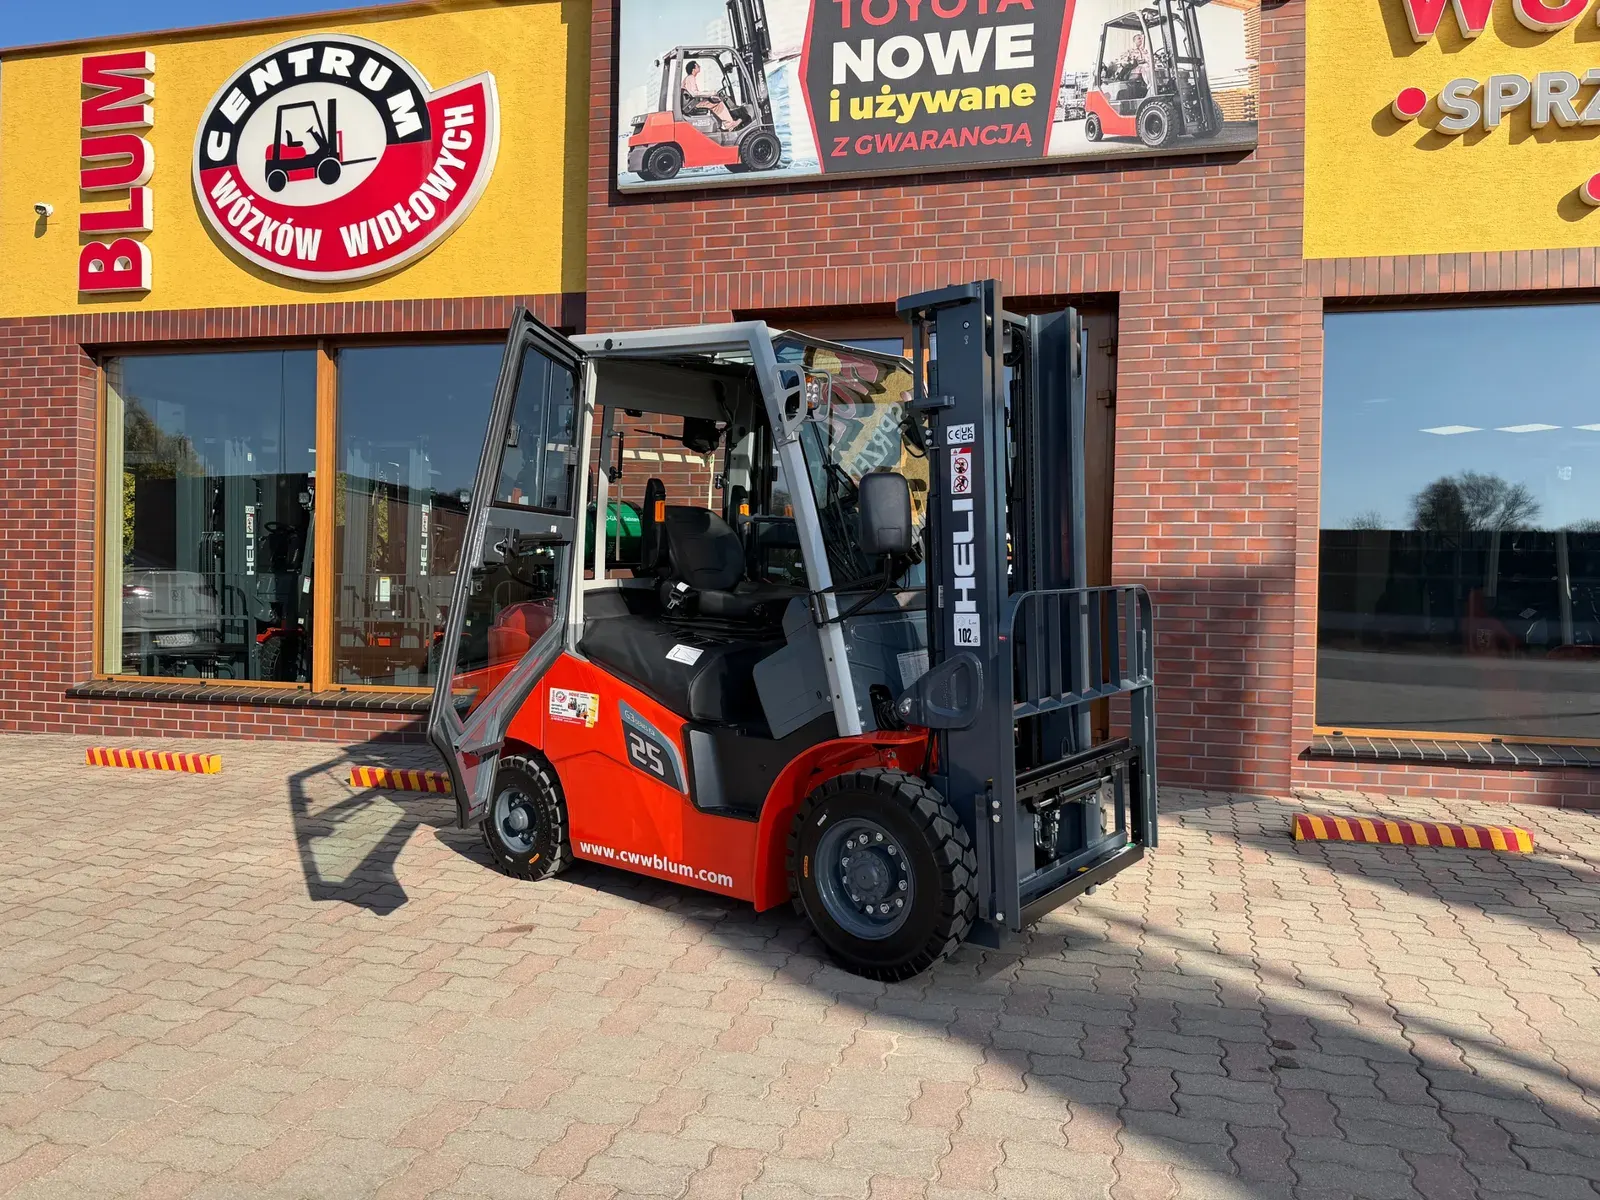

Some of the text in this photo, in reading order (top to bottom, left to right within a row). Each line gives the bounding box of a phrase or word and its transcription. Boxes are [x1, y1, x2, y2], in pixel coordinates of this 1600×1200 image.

[832, 0, 1035, 28] TOYO
[832, 23, 1035, 85] NOWE
[207, 46, 423, 162] CENTRUM
[829, 82, 1037, 124] i używane
[830, 122, 1033, 157] Z GWARANCJĄ
[79, 51, 155, 293] BLUM
[210, 103, 475, 261] WÓZKÓW WIDŁOWYCH
[246, 533, 255, 576] HELI
[420, 532, 429, 576] HELI
[952, 498, 977, 613] HELI
[958, 628, 972, 643] 102
[629, 732, 665, 776] 25
[579, 841, 733, 888] www.cwwblum.com
